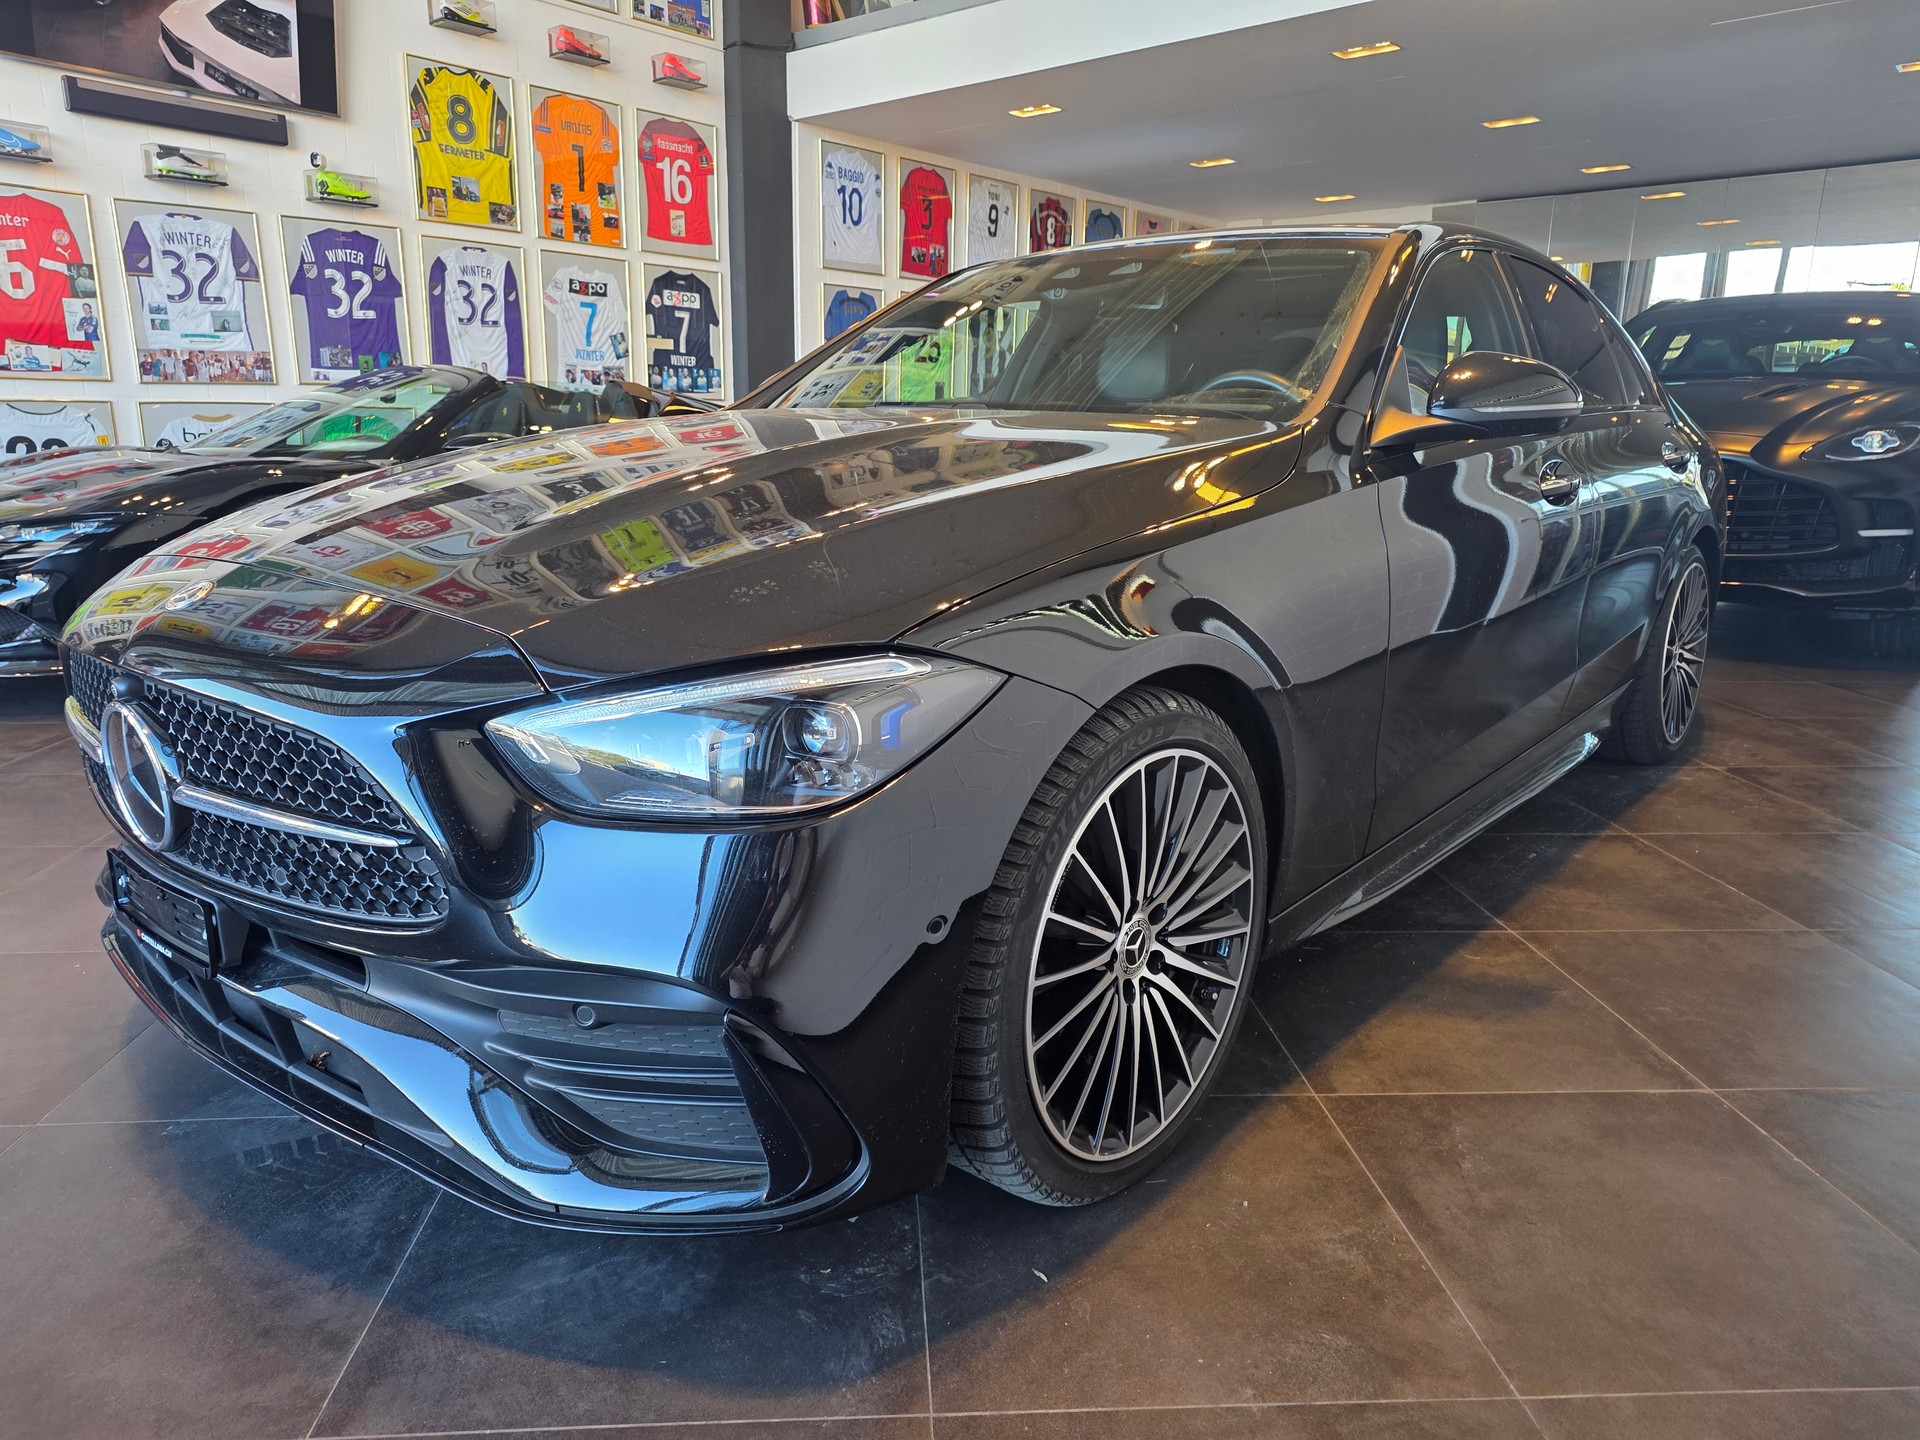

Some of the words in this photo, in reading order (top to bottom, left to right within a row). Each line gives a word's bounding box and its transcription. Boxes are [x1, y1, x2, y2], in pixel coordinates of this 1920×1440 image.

[446, 94, 477, 145] 8
[438, 143, 487, 161] SERMETER
[657, 137, 694, 154] fassnacht
[571, 143, 585, 192] 1
[655, 156, 693, 205] 16
[837, 166, 864, 184] BAGGIO
[836, 184, 863, 227] 10
[921, 195, 933, 231] 3
[987, 203, 999, 238] 9
[163, 231, 212, 249] WINTER
[325, 249, 365, 266] WINTER
[161, 249, 227, 305] 32
[459, 265, 493, 280] WINTER
[324, 268, 377, 320] 32
[457, 279, 502, 328] 32
[580, 301, 598, 347] 7
[674, 310, 690, 354] 7
[575, 347, 605, 362] WINTER
[670, 354, 696, 367] WINTER
